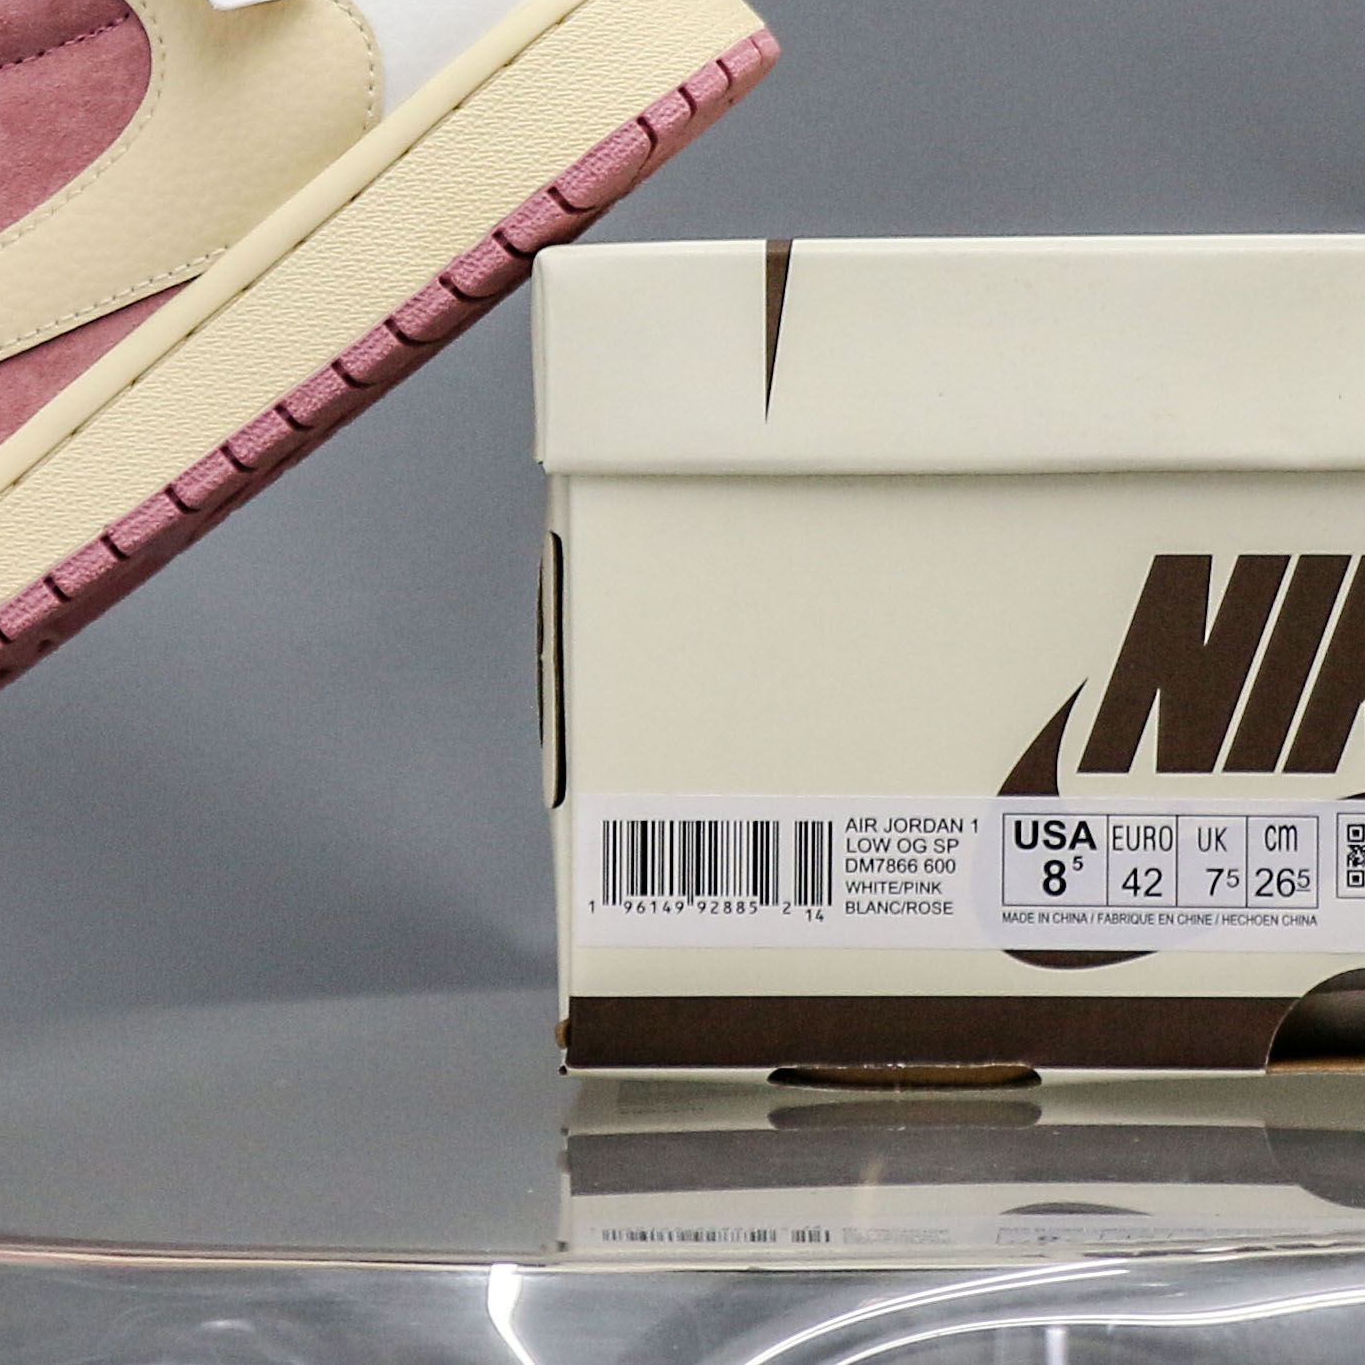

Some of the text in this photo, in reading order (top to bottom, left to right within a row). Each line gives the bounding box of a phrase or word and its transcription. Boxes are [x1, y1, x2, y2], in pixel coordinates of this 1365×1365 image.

[844, 817, 979, 834] AIR JORDAN 1
[1014, 820, 1097, 852] USA
[1111, 824, 1174, 853] EURO
[1197, 827, 1228, 853] UK
[846, 837, 960, 854] LOW OG SP
[845, 857, 957, 875] DM7866 600
[845, 880, 943, 895] WHITE/PINK
[1121, 867, 1163, 898] 42
[623, 900, 685, 915] 96149
[696, 900, 759, 915] 92885
[845, 900, 954, 916] BLANC/ROSE
[1002, 912, 1035, 925] MADE
[1037, 912, 1050, 925] IN
[1052, 912, 1088, 925] CHINA
[1097, 913, 1155, 926] FABRIQUE
[1158, 913, 1175, 926] EN
[1176, 913, 1213, 926] CHINE
[1221, 914, 1278, 927] HECHOEN
[1281, 915, 1318, 927] CHINA
